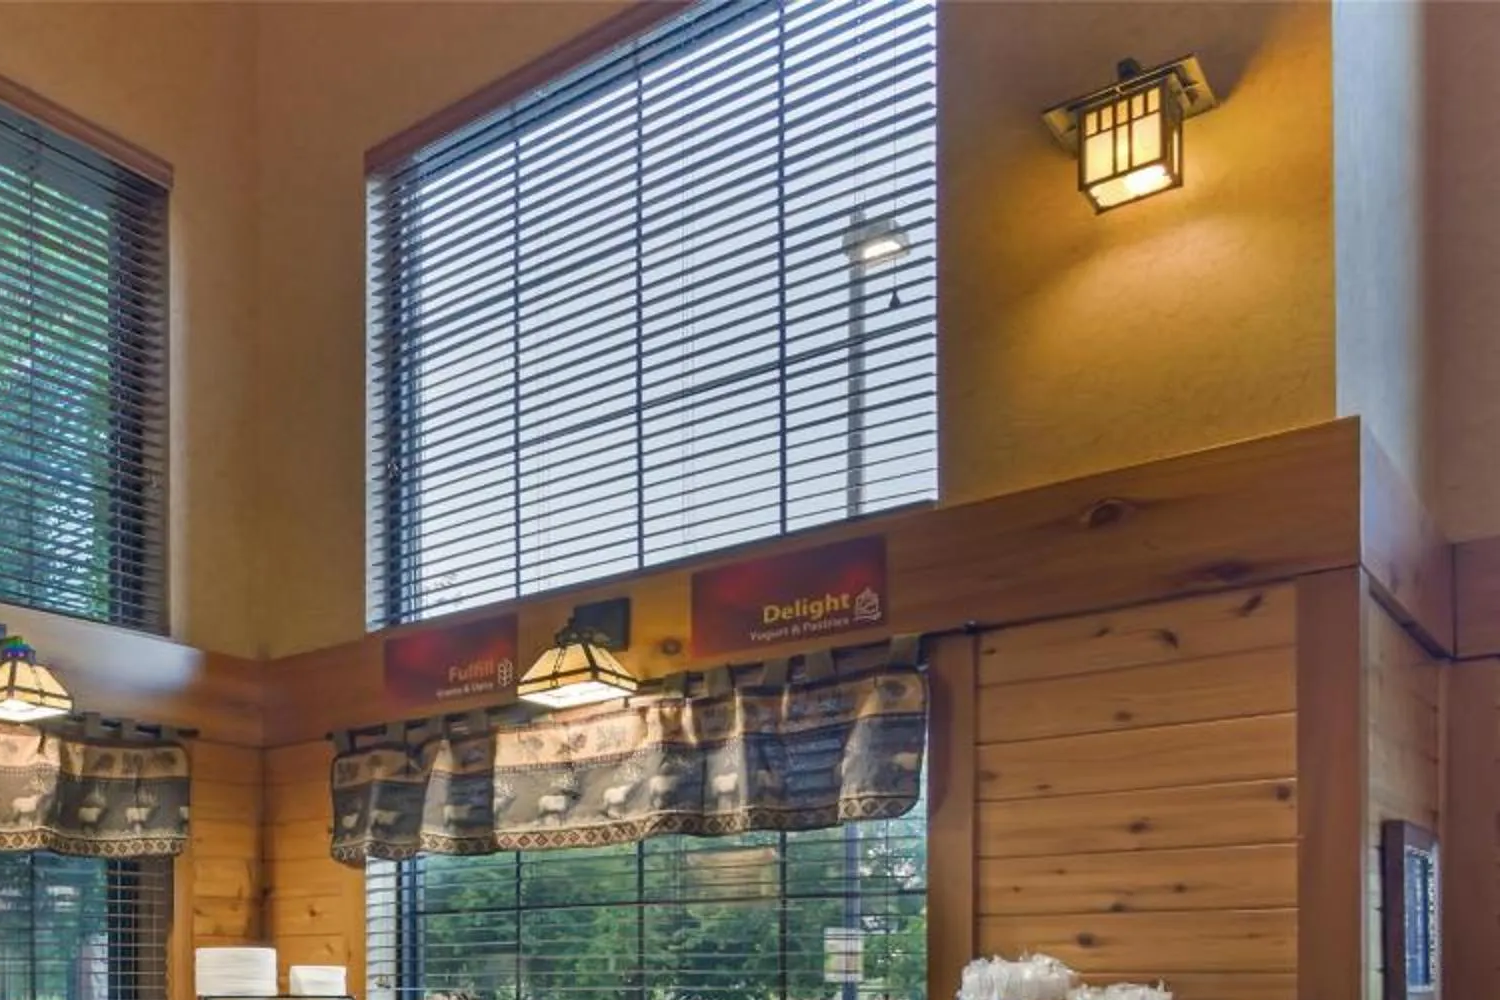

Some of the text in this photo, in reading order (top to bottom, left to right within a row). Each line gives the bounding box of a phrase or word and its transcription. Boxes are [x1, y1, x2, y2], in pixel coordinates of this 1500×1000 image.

[762, 592, 850, 624] Delight
[750, 625, 789, 642] Yogurt
[803, 616, 849, 632] Pastries
